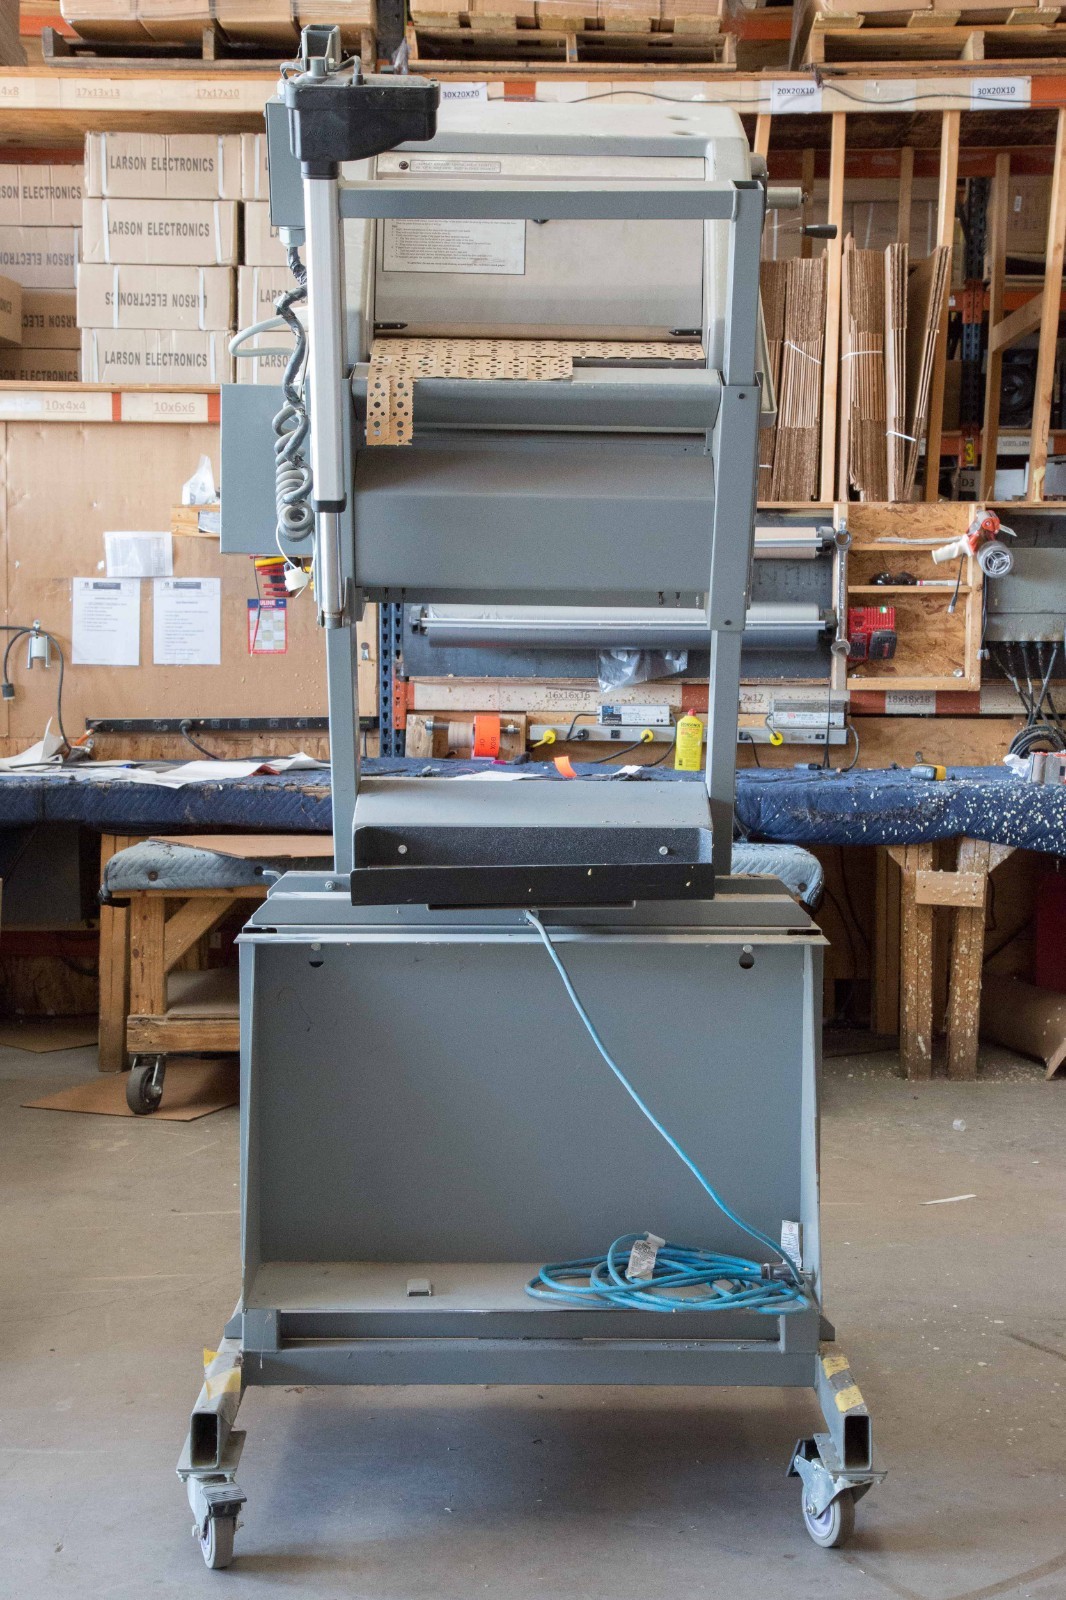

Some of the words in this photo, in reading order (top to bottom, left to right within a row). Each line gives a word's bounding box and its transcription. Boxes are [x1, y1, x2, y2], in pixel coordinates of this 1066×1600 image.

[76, 87, 120, 97] 17x13x13
[196, 88, 240, 98] 17x17x10
[443, 90, 480, 98] 30X20X20
[777, 87, 815, 95] 20X20X10
[978, 86, 1016, 95] 30X20X10
[110, 155, 147, 170] LARSON
[151, 157, 214, 172] ELECTRONICS
[0, 186, 19, 199] SON
[23, 186, 82, 199] ELECTRONICS
[107, 221, 143, 235] LARSON
[147, 222, 210, 237] ELECTRONICS
[104, 351, 141, 365] LARSON
[146, 353, 208, 367] ELECTRONICS
[20, 369, 78, 382] ELECTRONICS
[45, 400, 86, 411] 10x4x4
[154, 401, 196, 412] 10x6x6
[965, 443, 974, 462] 3
[548, 691, 591, 699] 16x16x16
